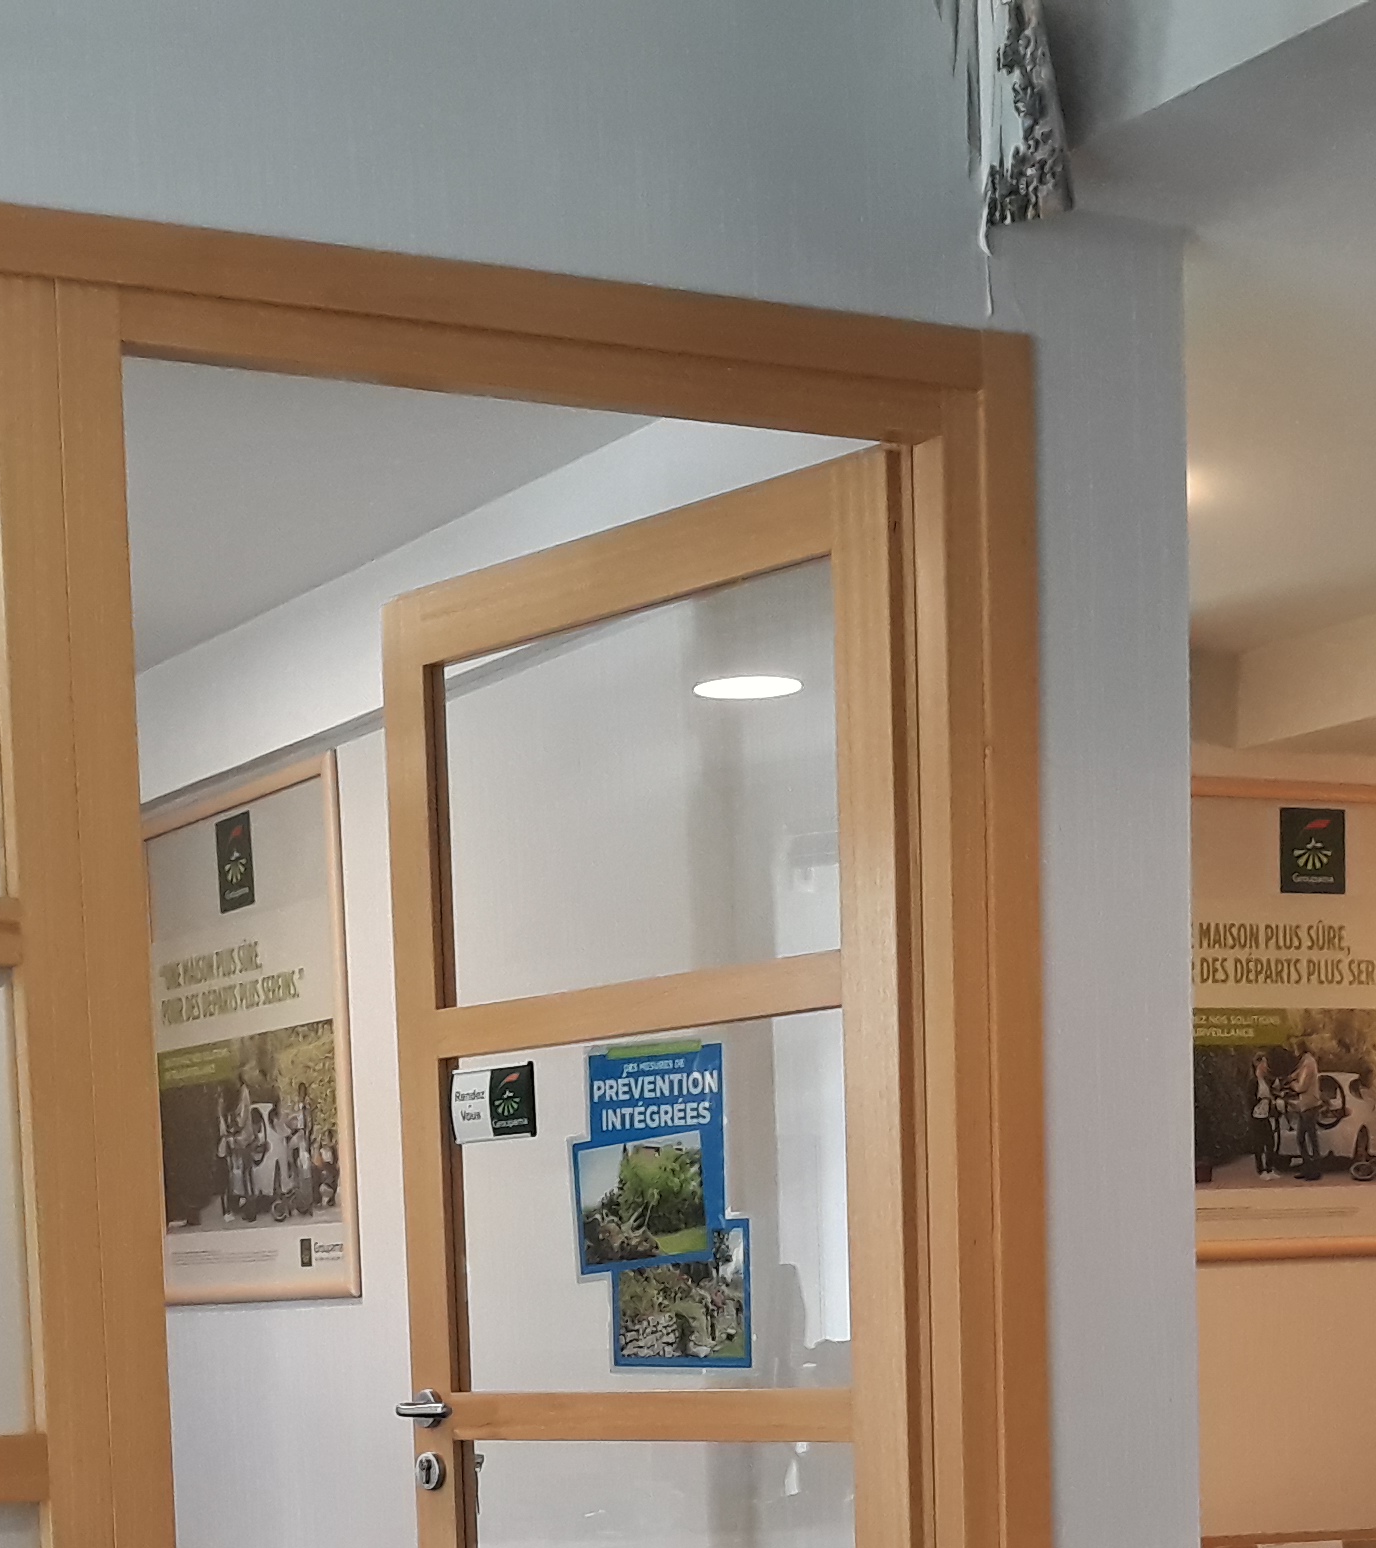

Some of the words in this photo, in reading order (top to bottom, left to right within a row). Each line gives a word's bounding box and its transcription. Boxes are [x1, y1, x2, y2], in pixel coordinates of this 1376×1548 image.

[1198, 922, 1260, 950] MAISON
[1265, 924, 1302, 951] PLUS
[1307, 920, 1351, 956] SÛRE,
[1199, 957, 1229, 984] DES
[1233, 953, 1303, 985] DÉPARTS
[1307, 958, 1345, 985] PLUS
[593, 1069, 719, 1104] PRÉVENTION
[601, 1098, 711, 1132] INTÉGRÉES
